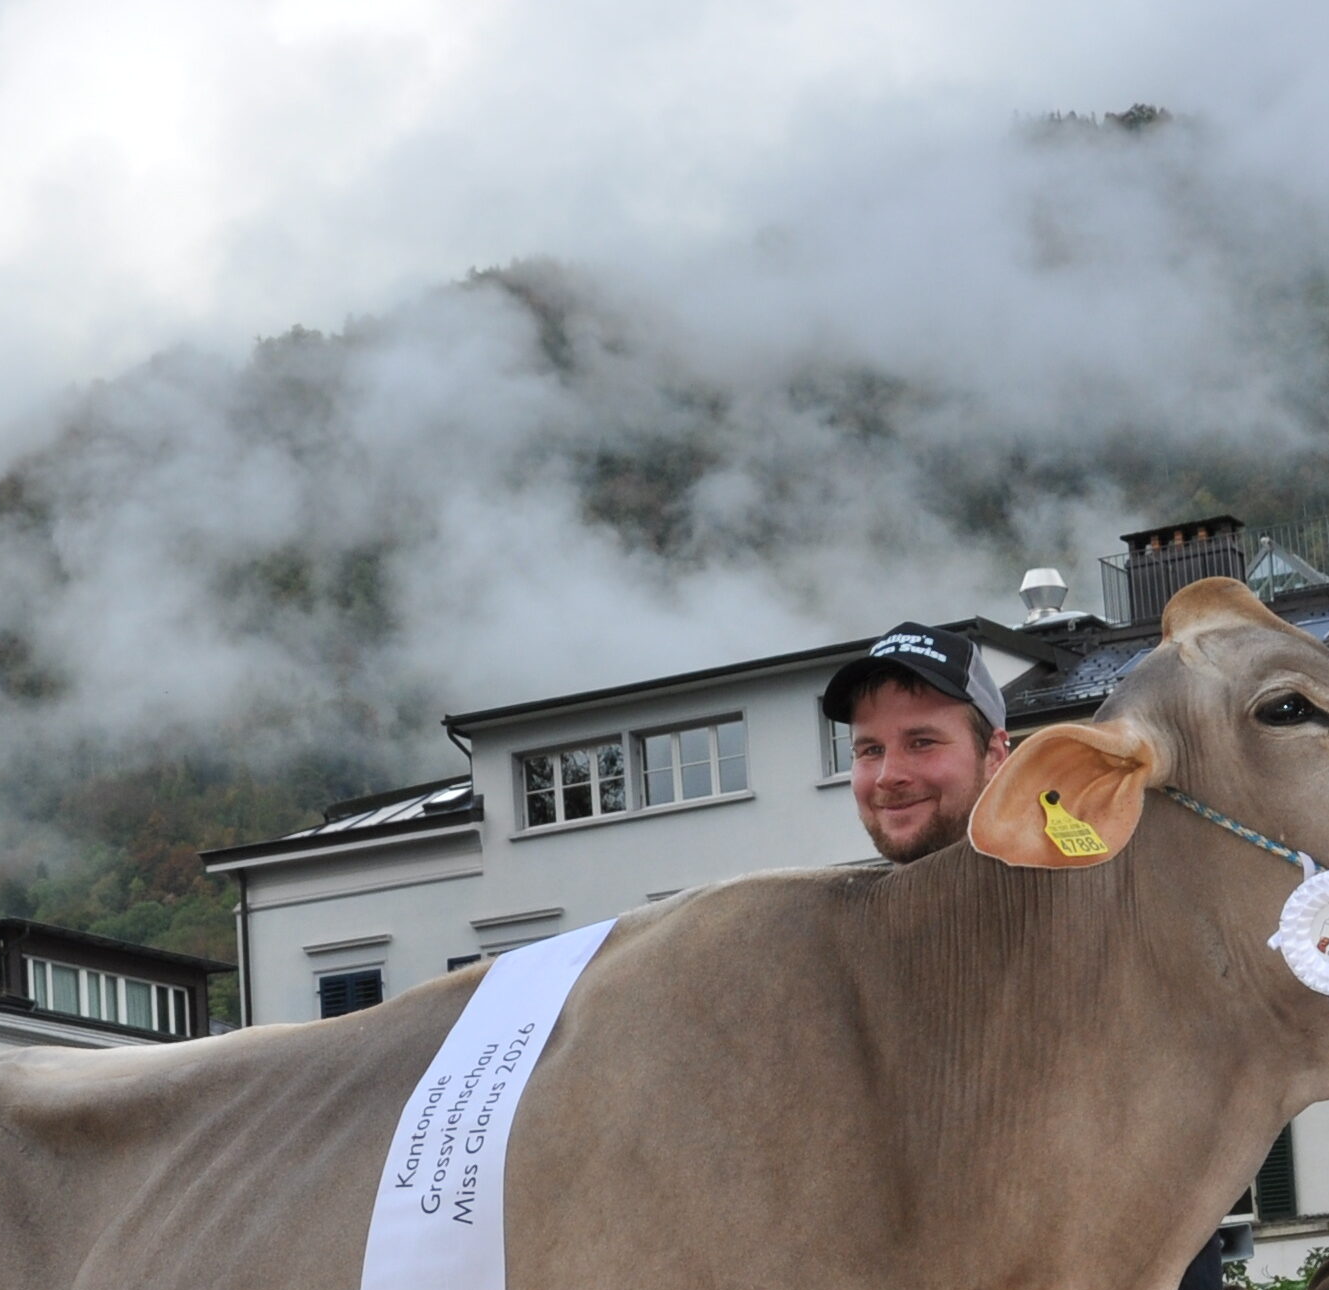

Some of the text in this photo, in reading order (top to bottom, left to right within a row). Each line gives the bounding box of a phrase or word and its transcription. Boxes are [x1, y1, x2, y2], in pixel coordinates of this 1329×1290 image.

[899, 643, 947, 663] Swiss
[1060, 837, 1100, 853] 4788
[395, 1075, 452, 1188] Kantonale
[421, 1043, 499, 1214] Grossviehschau
[452, 1022, 535, 1224] Miss Glarus 2026
